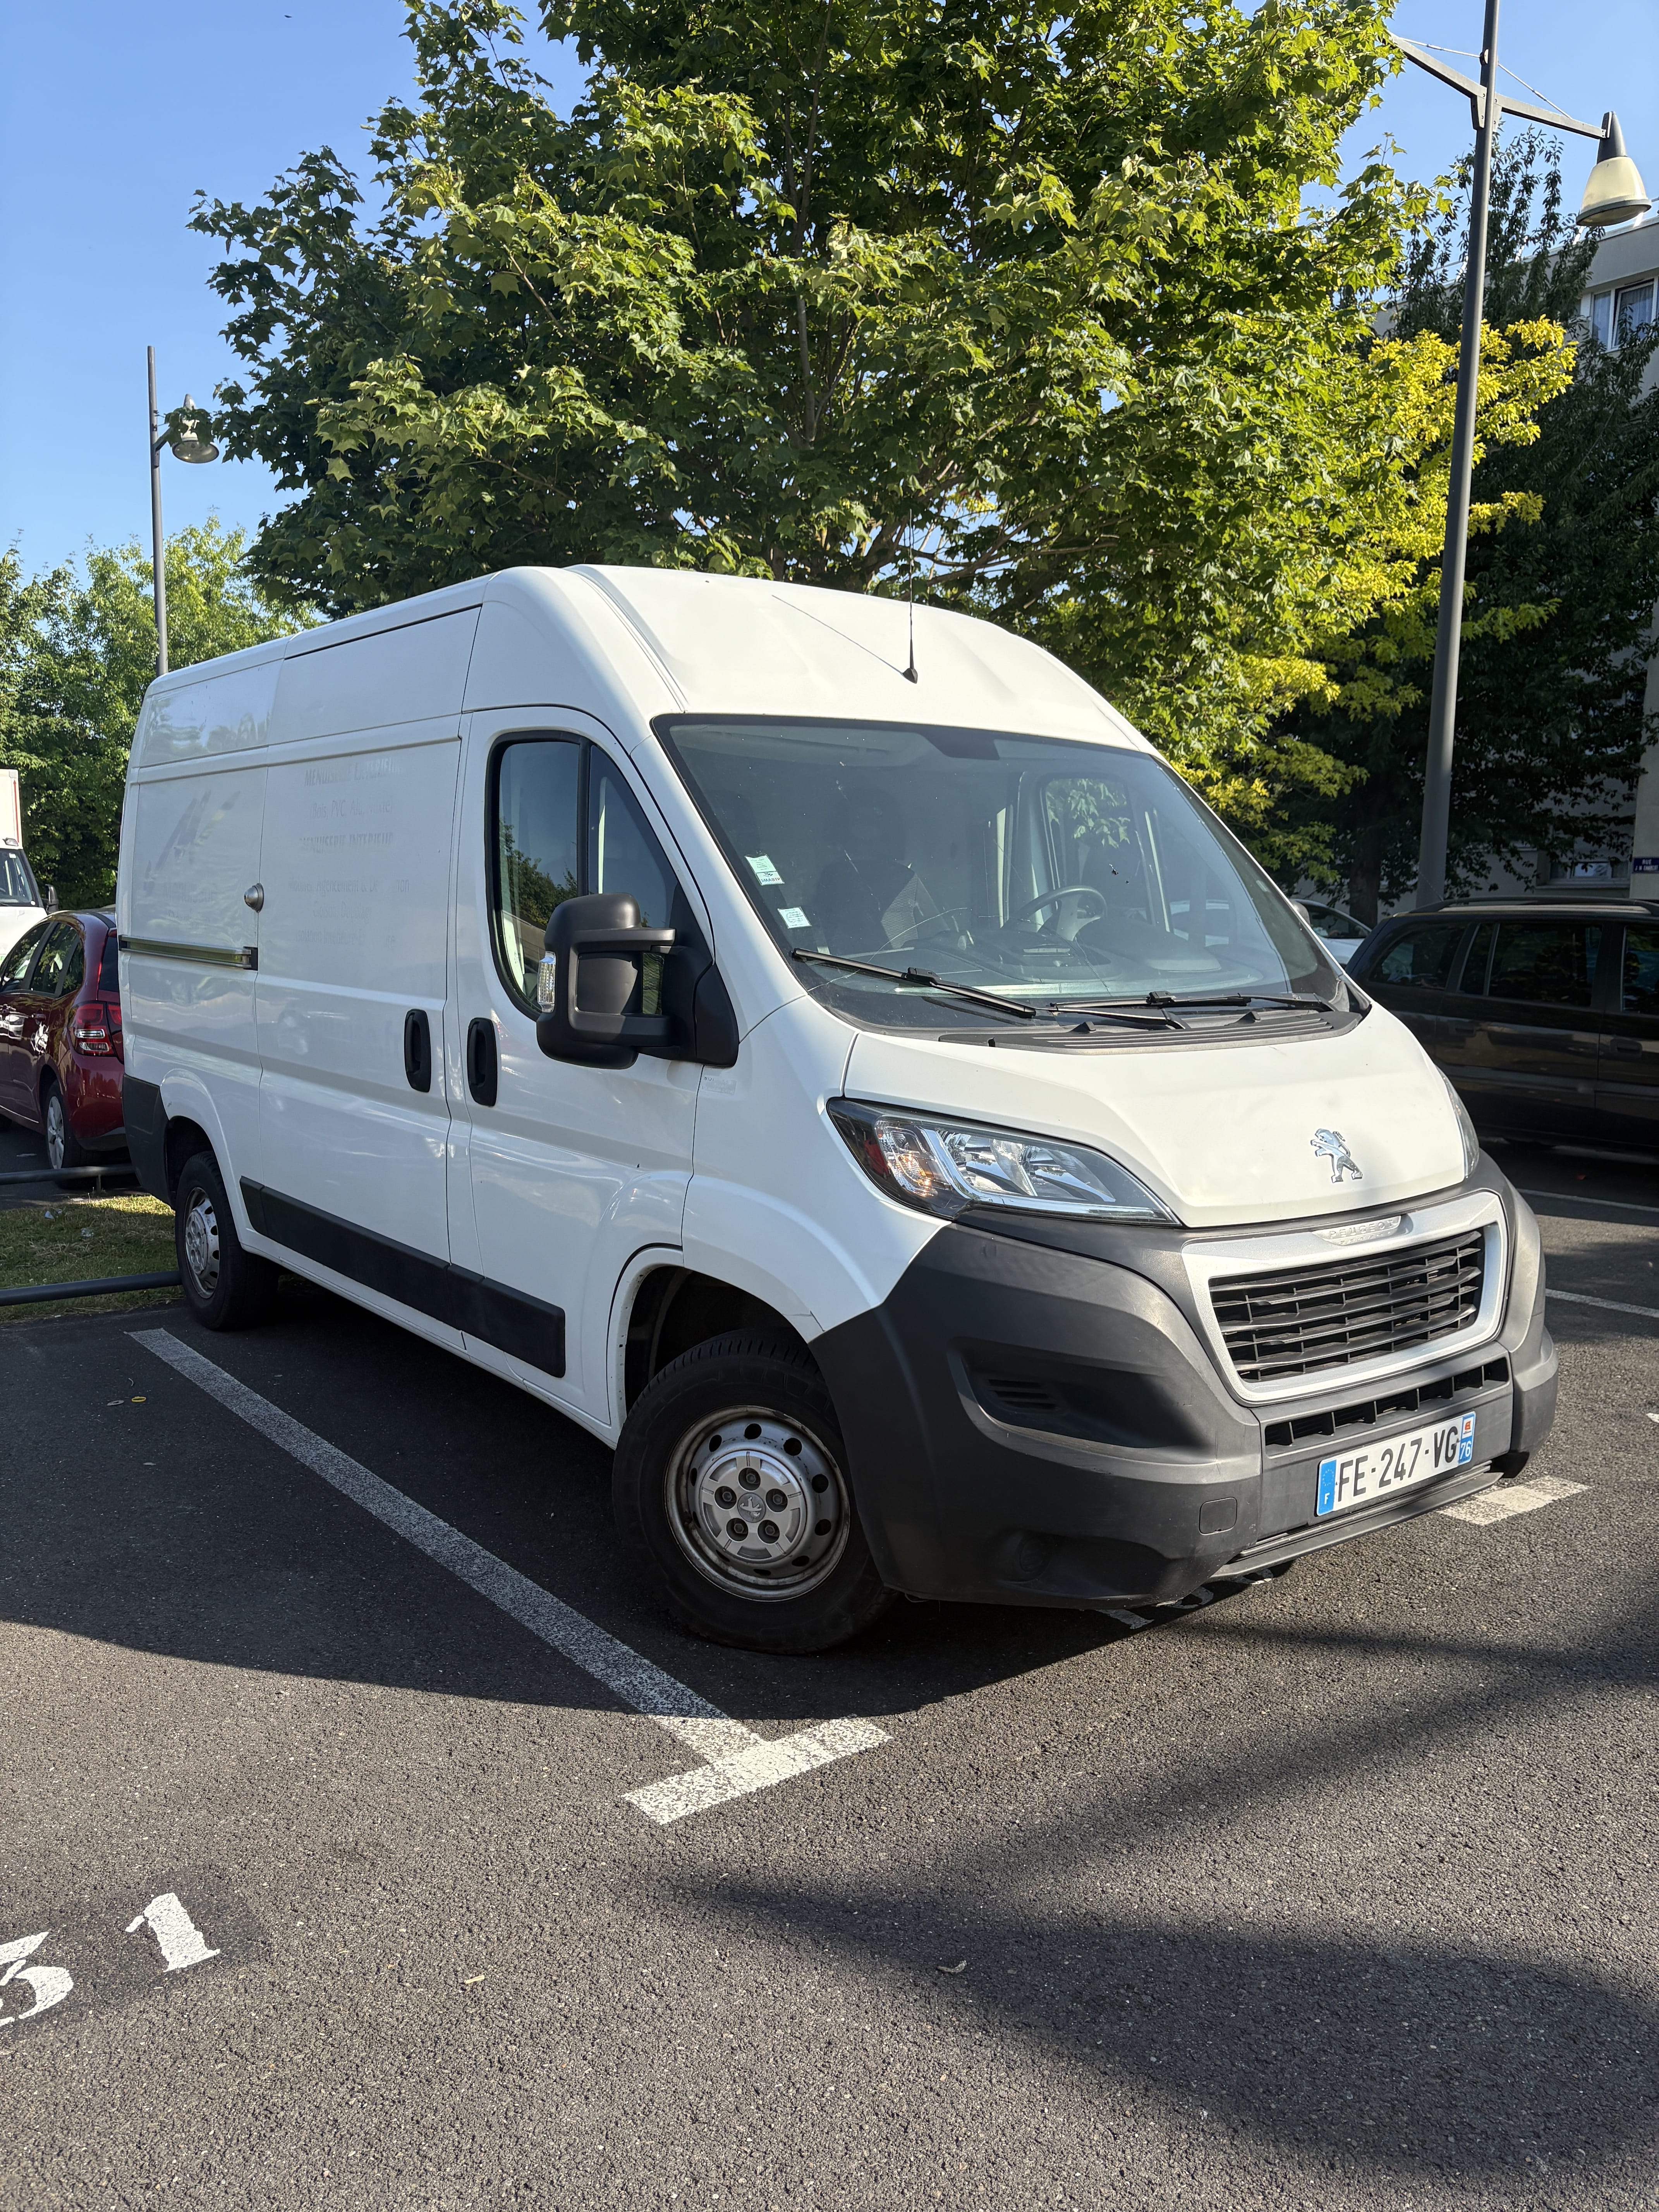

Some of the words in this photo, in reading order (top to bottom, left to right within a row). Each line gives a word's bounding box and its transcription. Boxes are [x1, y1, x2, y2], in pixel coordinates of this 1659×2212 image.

[1329, 1219, 1394, 1239] PEUGEOT
[1324, 1492, 1330, 1505] F
[1460, 1440, 1472, 1460] 76
